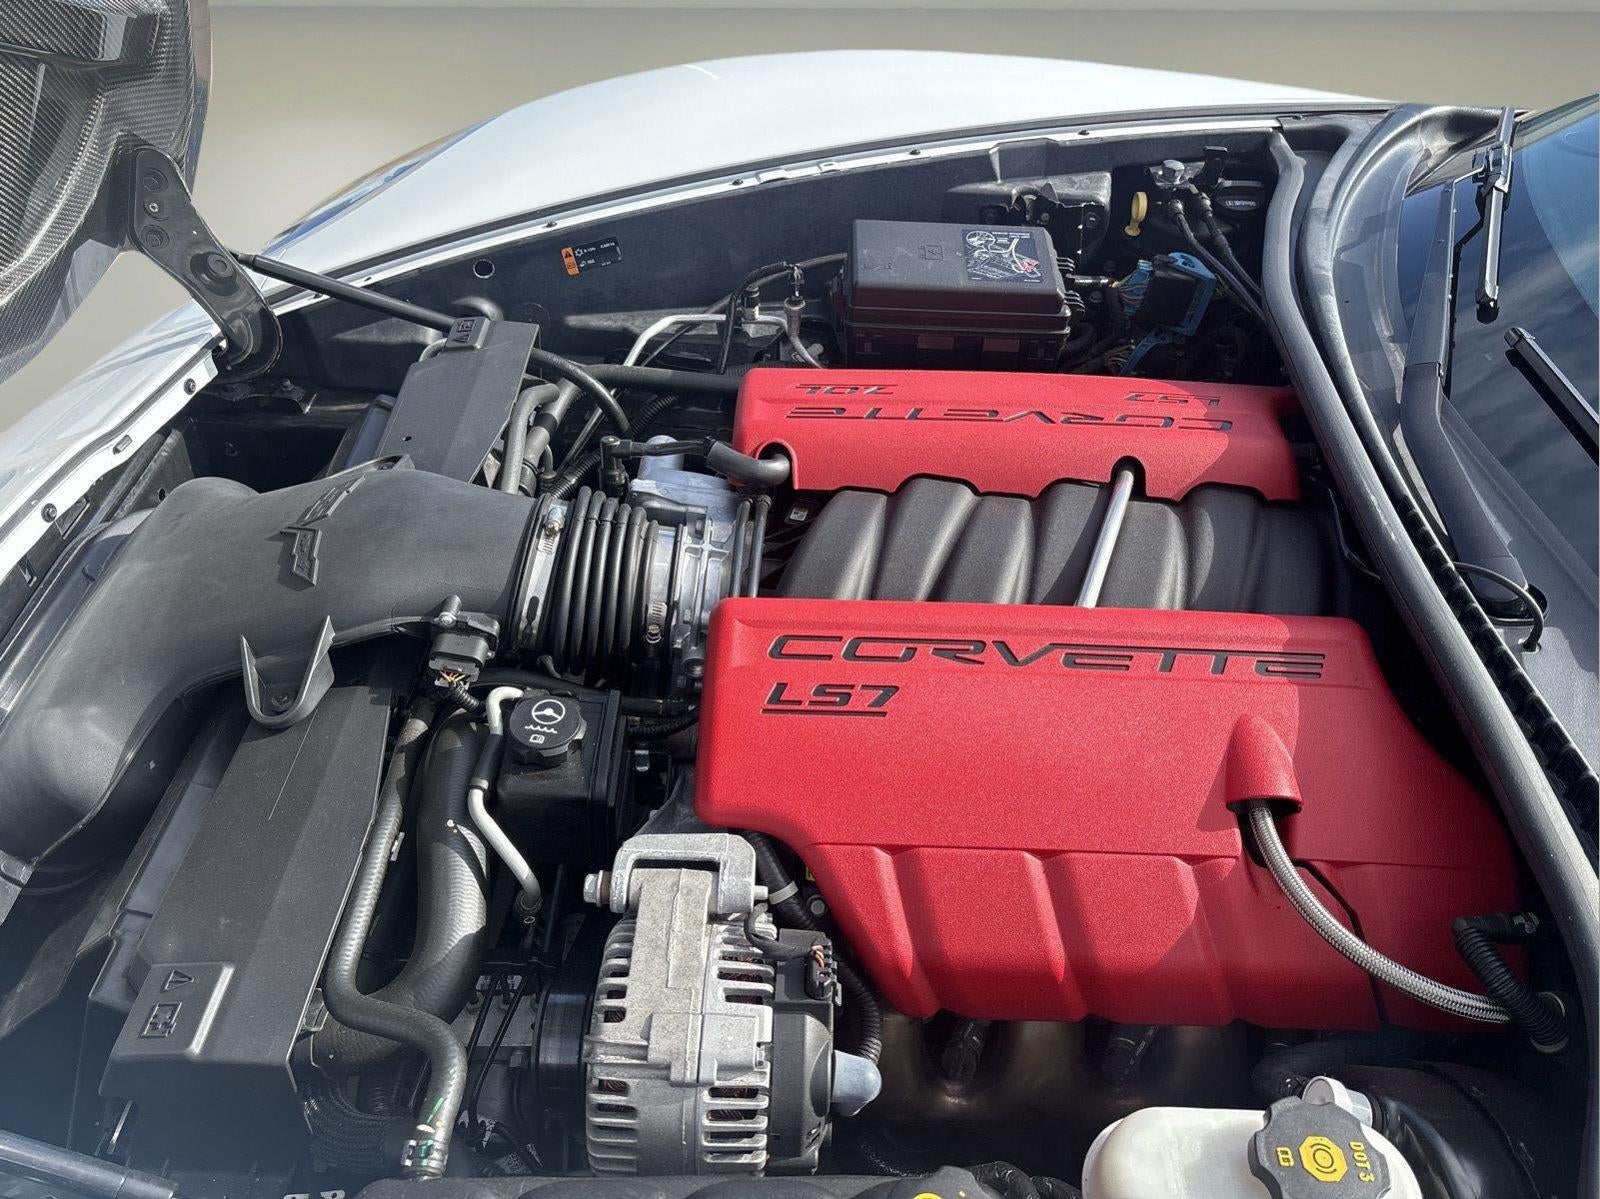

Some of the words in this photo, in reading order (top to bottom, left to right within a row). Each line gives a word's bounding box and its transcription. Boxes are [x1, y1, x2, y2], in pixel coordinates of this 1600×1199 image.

[785, 406, 1234, 433] CORVETTE
[768, 634, 1326, 679] CORVETTE
[765, 682, 900, 709] LS7
[1348, 1141, 1371, 1170] DOT
[1358, 1171, 1375, 1182] 3
